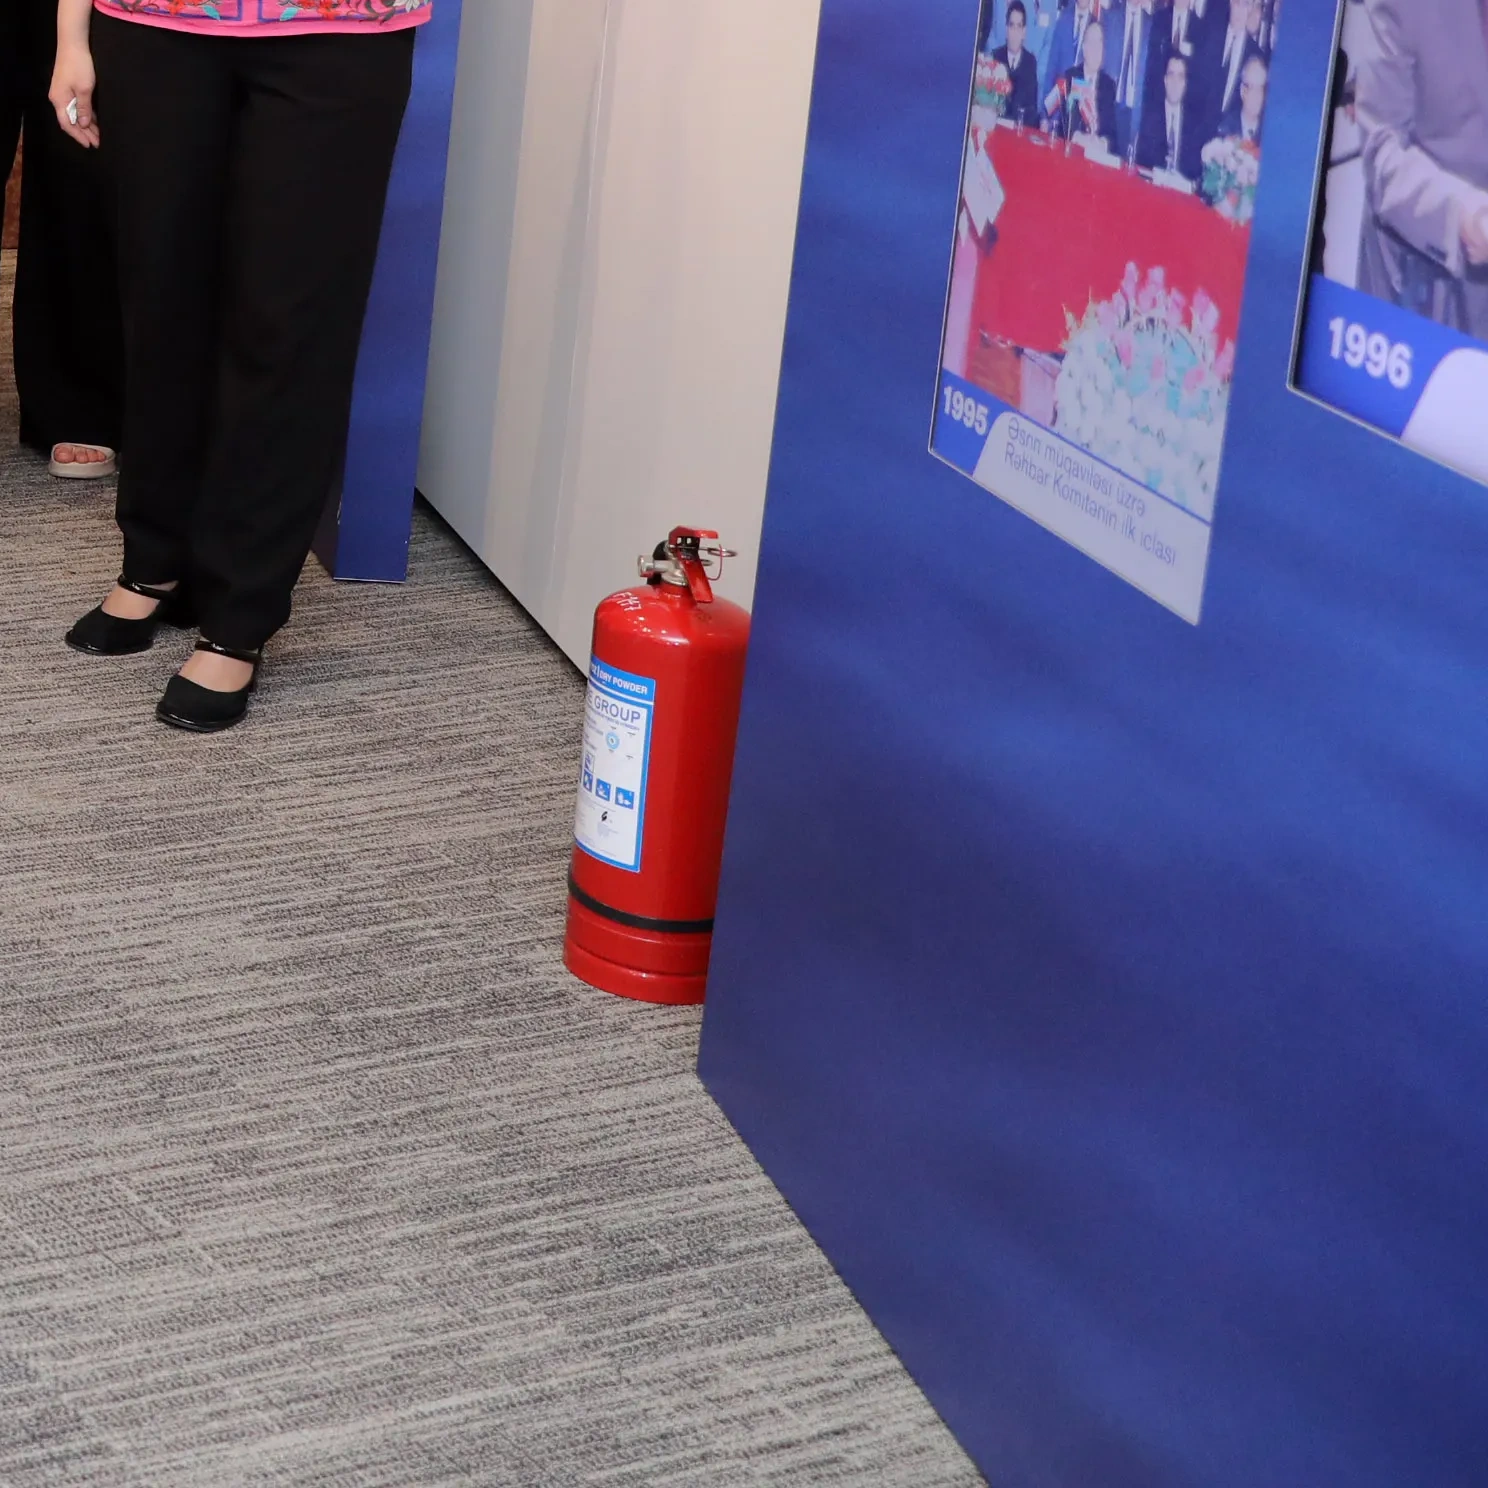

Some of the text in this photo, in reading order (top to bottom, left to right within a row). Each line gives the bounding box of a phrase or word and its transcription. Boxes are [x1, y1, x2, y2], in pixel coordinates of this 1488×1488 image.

[1329, 316, 1413, 389] 1996
[943, 385, 988, 436] 1995
[612, 676, 649, 695] POWDER
[594, 696, 641, 724] GROUP
